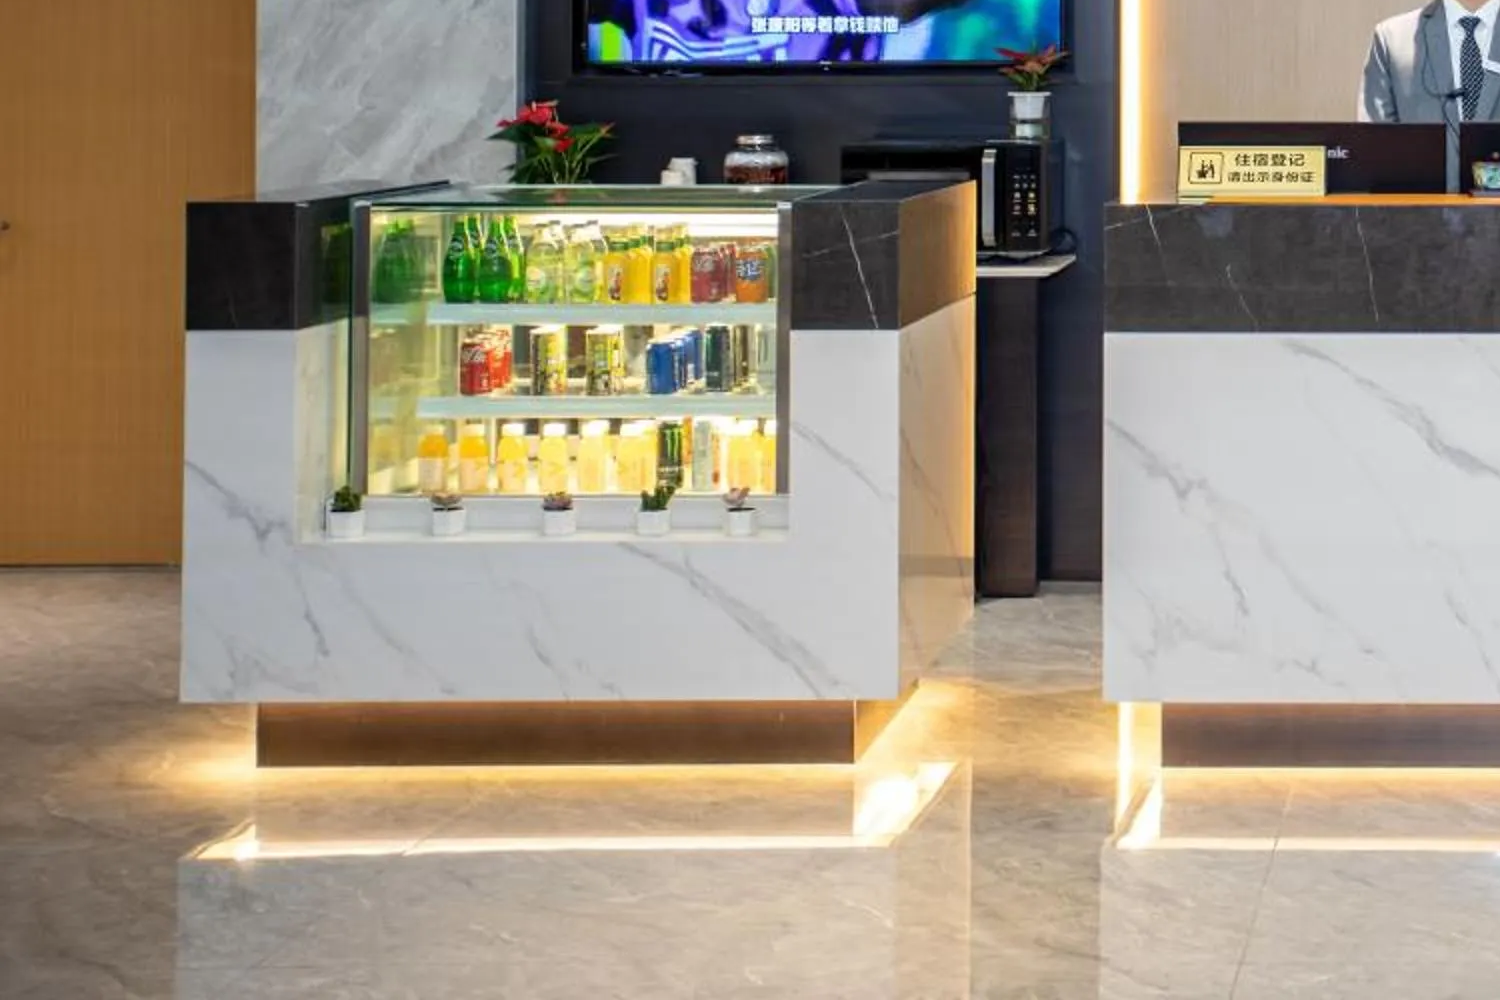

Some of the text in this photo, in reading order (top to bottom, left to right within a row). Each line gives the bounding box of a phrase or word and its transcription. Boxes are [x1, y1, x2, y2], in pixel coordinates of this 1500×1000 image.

[1234, 152, 1306, 167] 住宿登记
[1226, 171, 1317, 183] 请出示身份证
